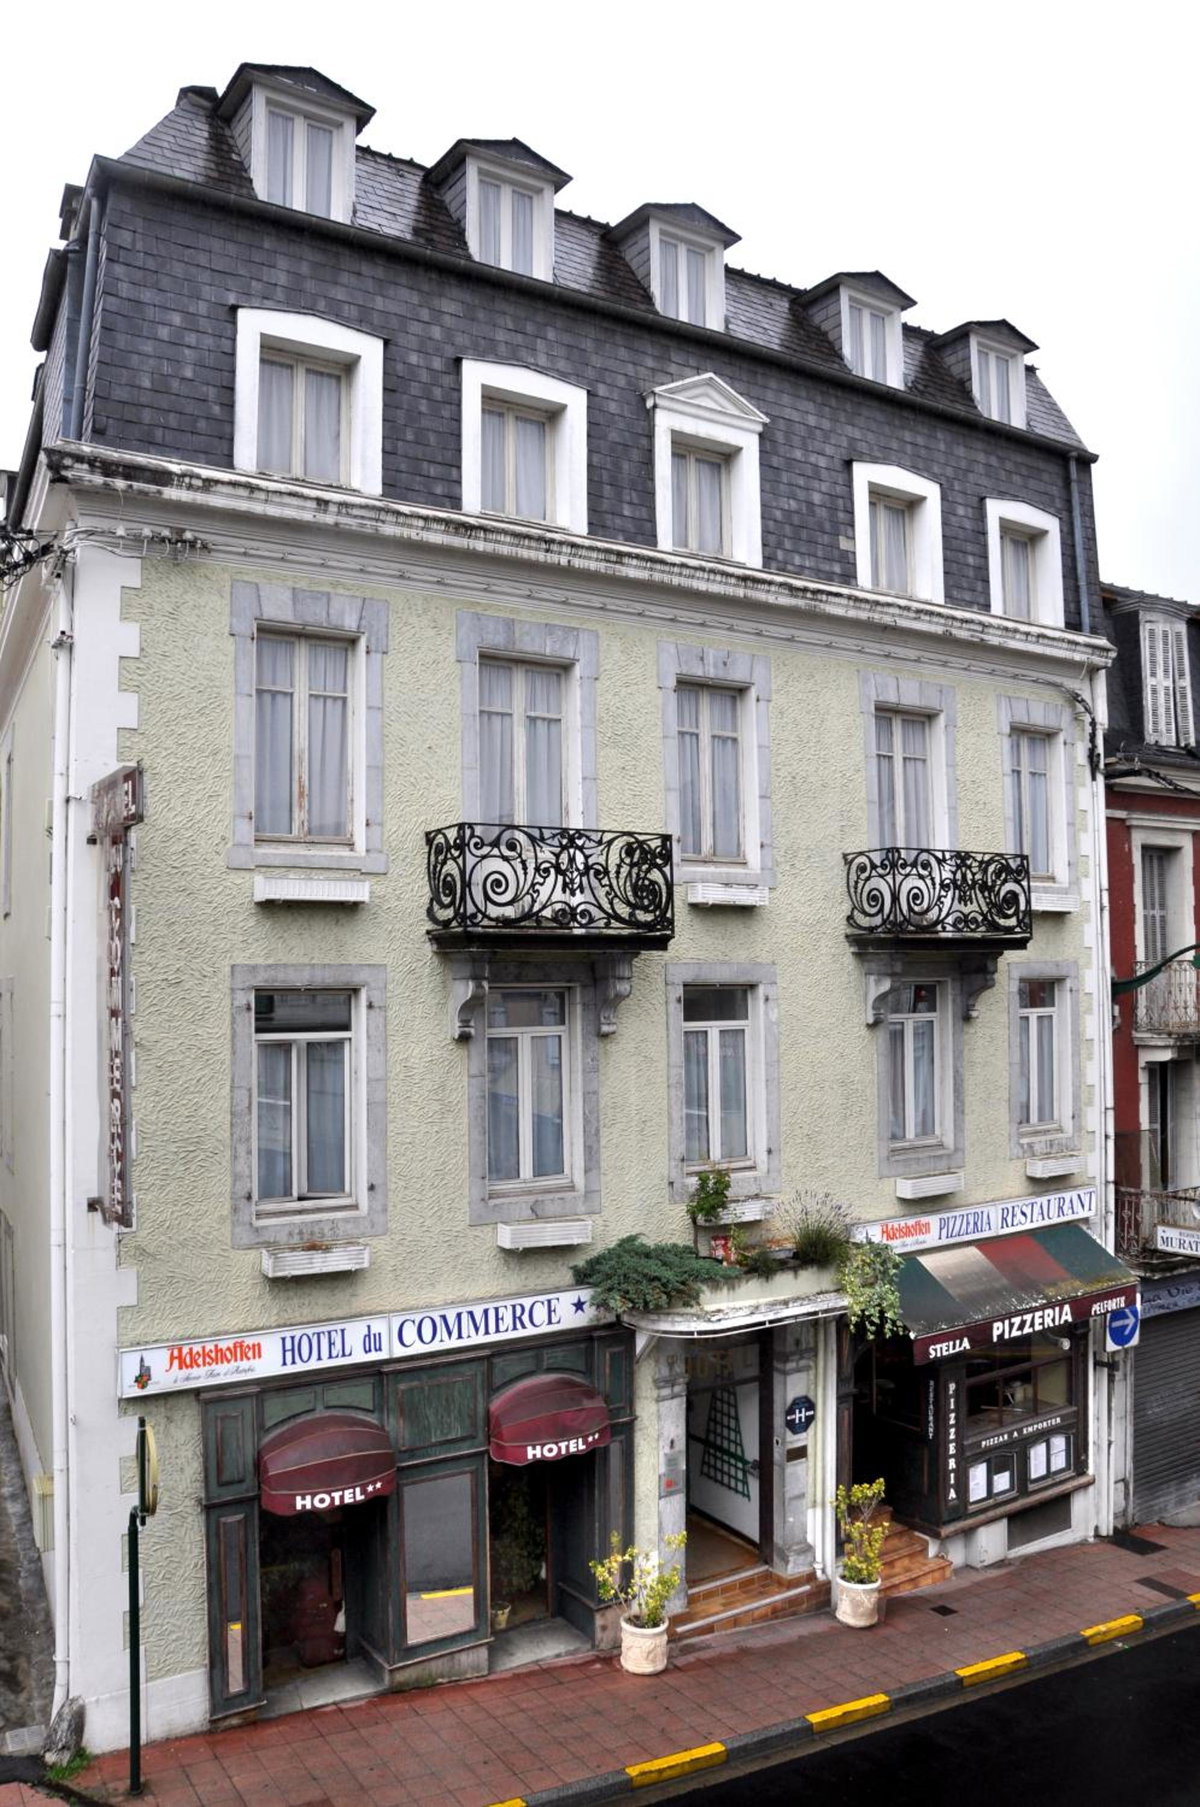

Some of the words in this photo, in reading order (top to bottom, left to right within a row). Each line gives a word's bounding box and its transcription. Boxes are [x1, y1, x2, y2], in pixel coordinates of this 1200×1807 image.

[938, 1210, 992, 1240] PIZZERIA
[1000, 1190, 1096, 1229] RESTAURANT
[280, 1327, 352, 1366] HOTEL
[362, 1324, 382, 1355] du
[397, 1298, 561, 1348] COMMERCE
[992, 1304, 1073, 1342] PIZZERIA
[165, 1339, 262, 1373] Adelshoffen
[929, 1337, 971, 1359] STELLA
[526, 1438, 587, 1460] HOTEL
[948, 1382, 957, 1500] PIZZERIA
[981, 1433, 1009, 1449] PIZZAS
[1022, 1417, 1061, 1435] EMPORTER
[295, 1487, 365, 1511] HOTEL
